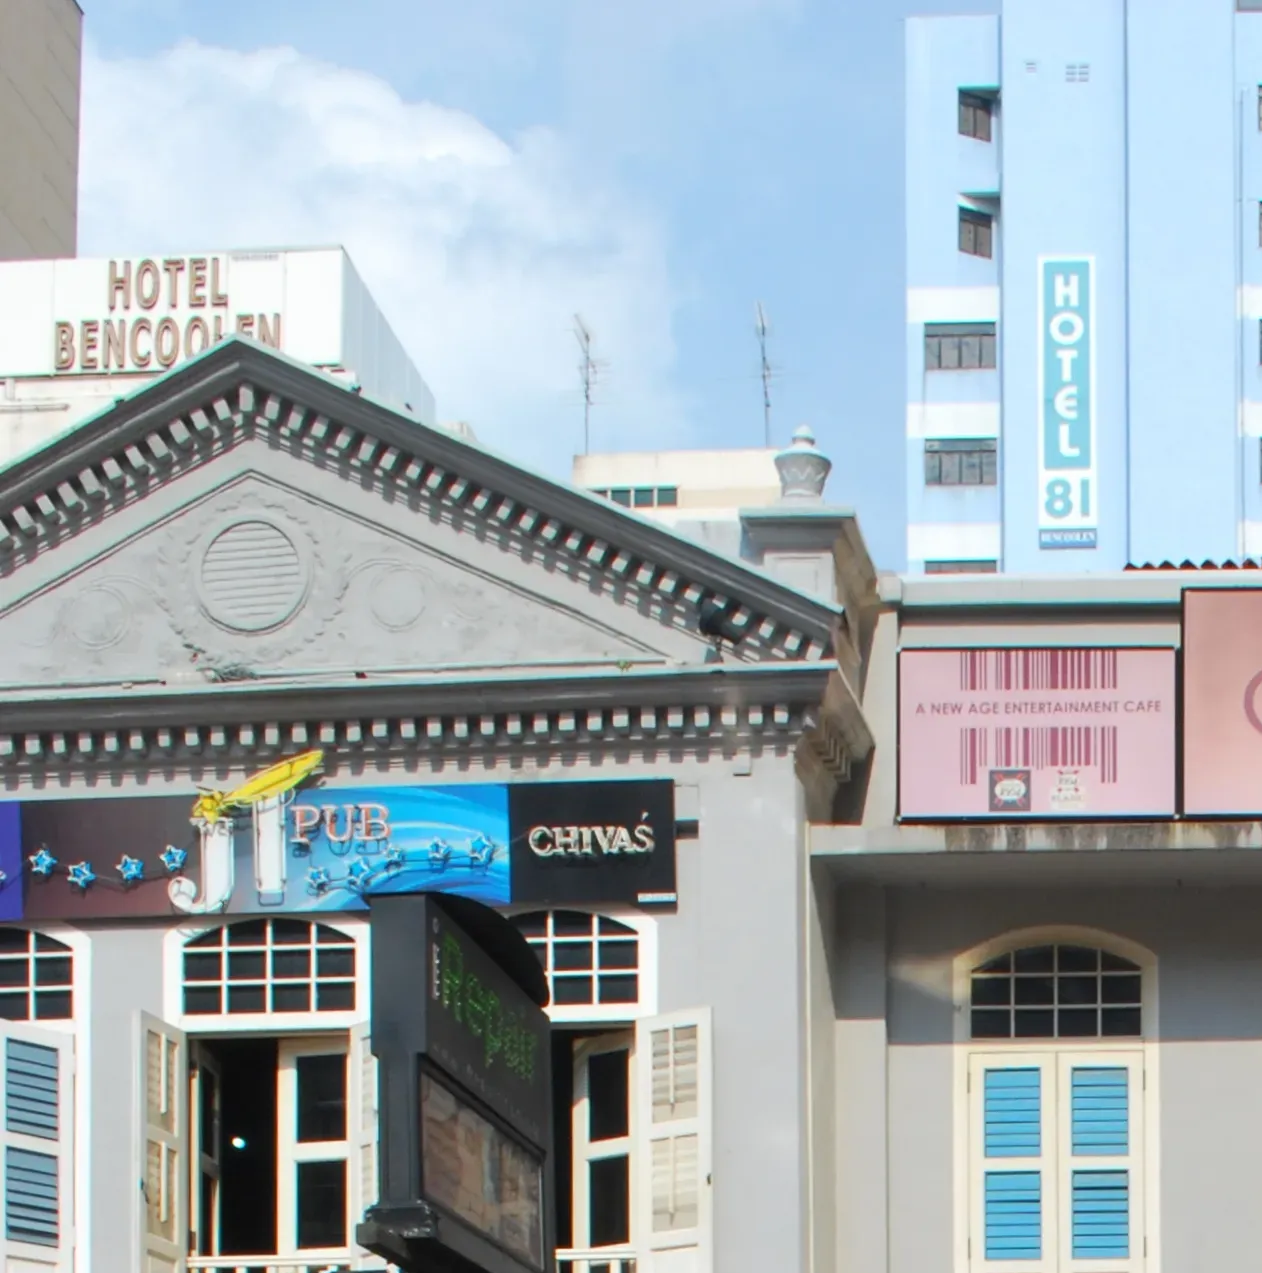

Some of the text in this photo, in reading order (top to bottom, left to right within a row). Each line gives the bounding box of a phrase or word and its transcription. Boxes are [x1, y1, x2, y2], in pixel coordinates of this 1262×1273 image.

[108, 257, 229, 311] HOTEL
[1049, 273, 1085, 457] HOTEL
[1044, 478, 1090, 518] 81
[915, 700, 1162, 715] A NEW AGE ENTERTAINMENT CAFE
[289, 803, 391, 844] PUB
